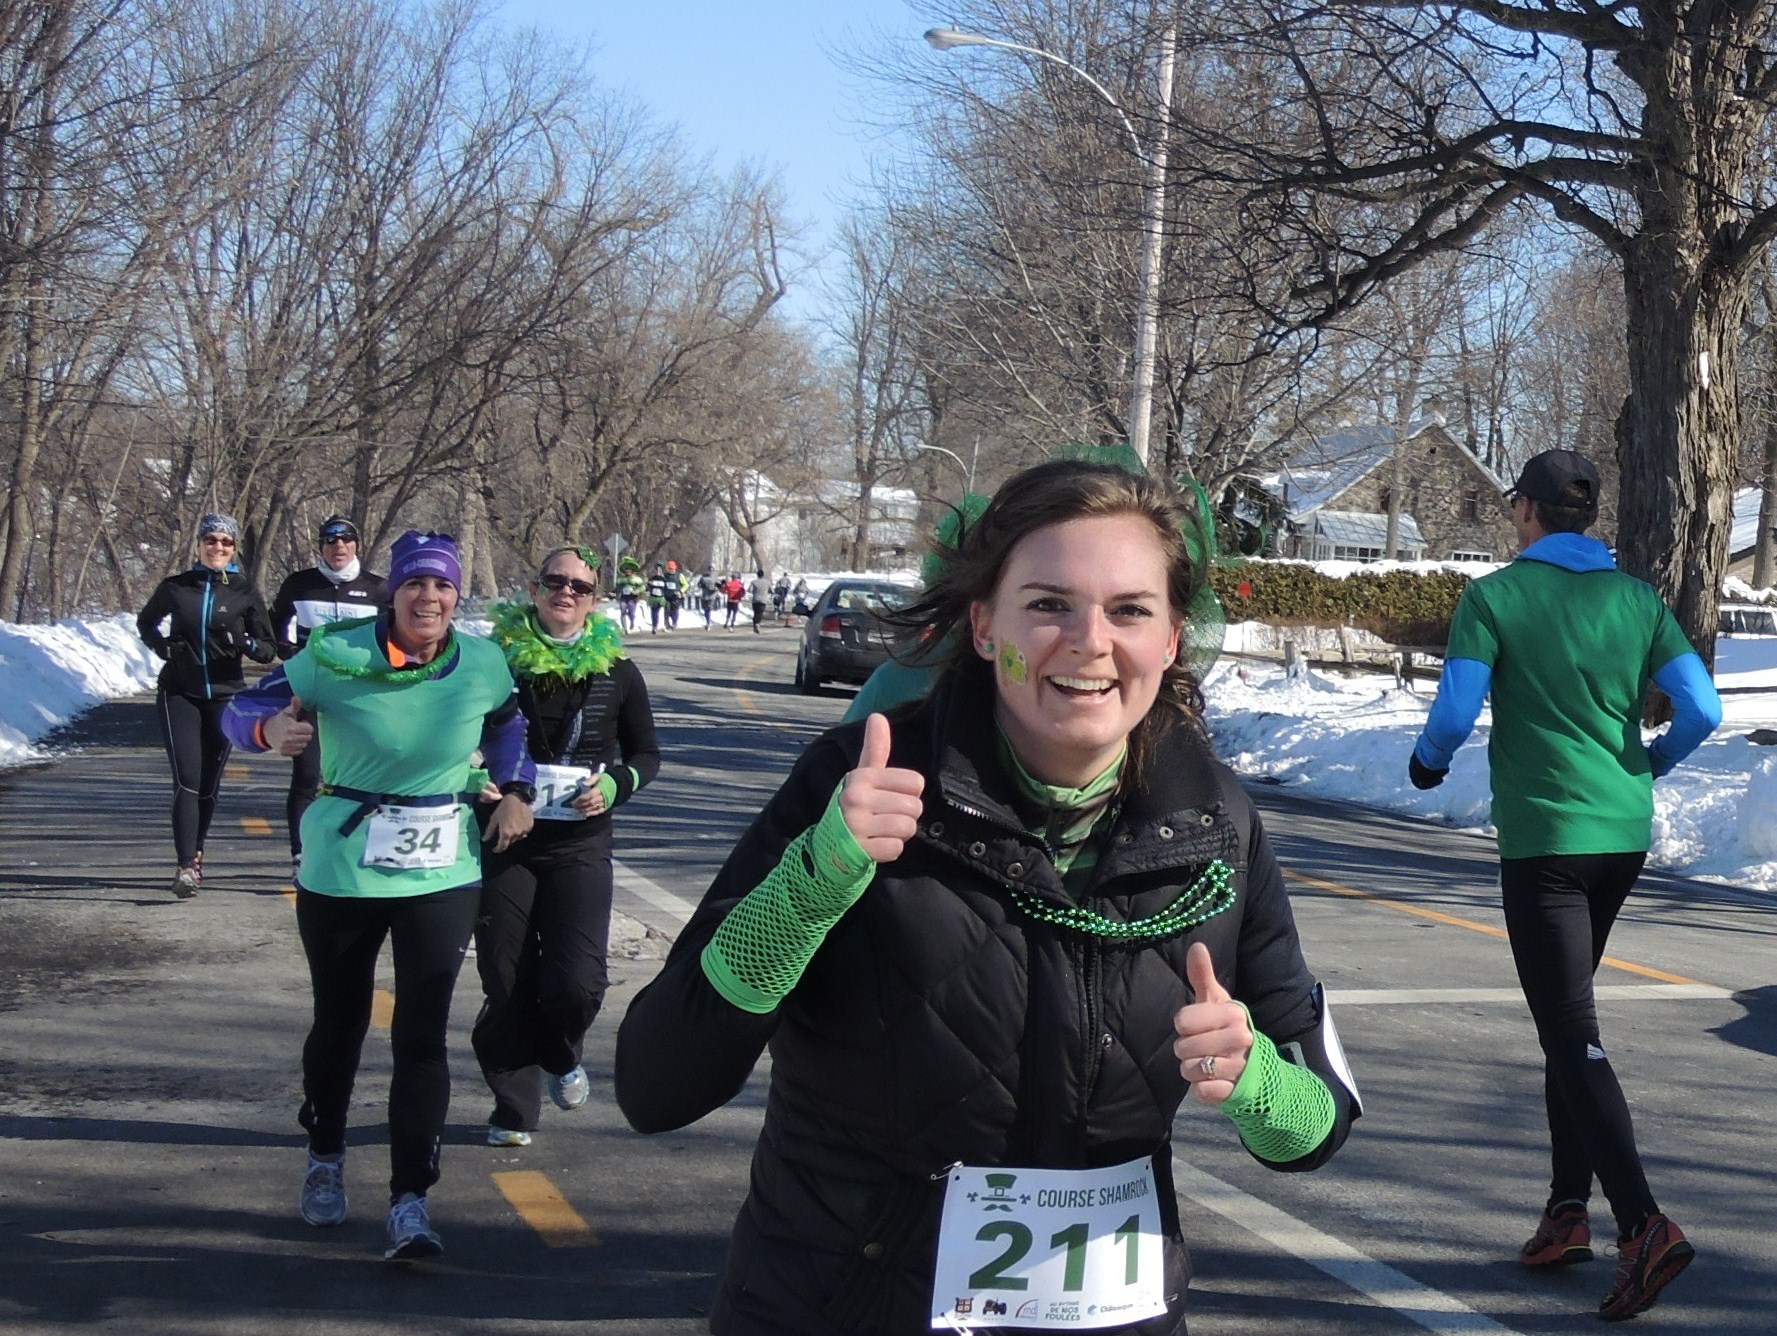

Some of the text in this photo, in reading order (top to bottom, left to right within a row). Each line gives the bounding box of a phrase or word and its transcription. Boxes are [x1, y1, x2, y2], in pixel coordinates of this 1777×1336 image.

[394, 827, 442, 855] 34
[1037, 1177, 1150, 1208] COURSE SHAMROCK
[968, 1213, 1140, 1292] 211
